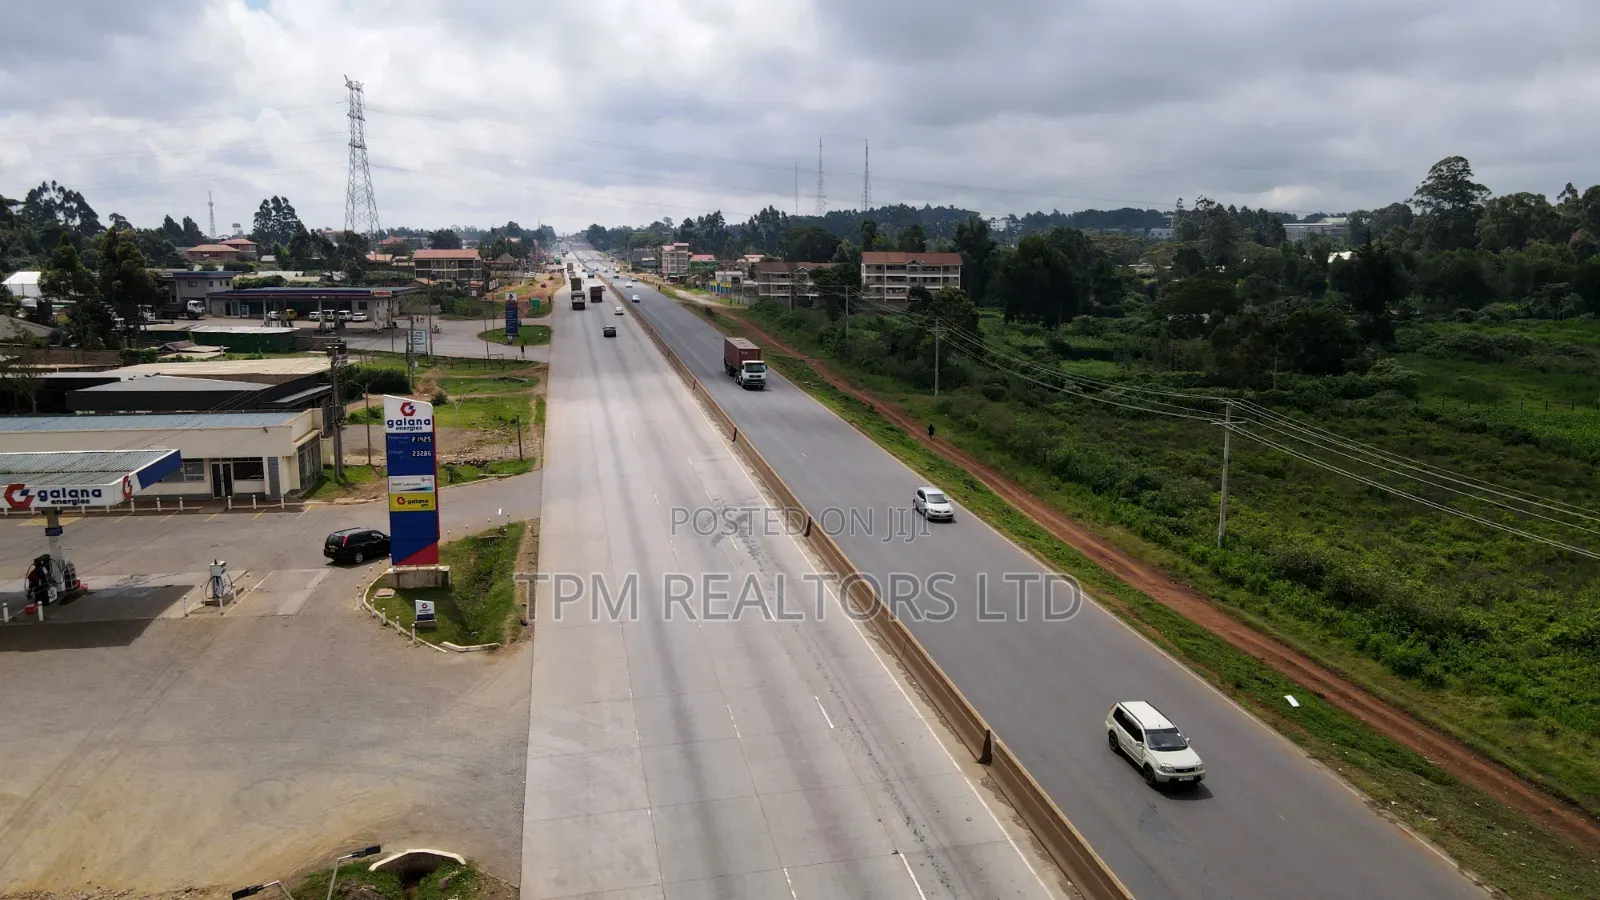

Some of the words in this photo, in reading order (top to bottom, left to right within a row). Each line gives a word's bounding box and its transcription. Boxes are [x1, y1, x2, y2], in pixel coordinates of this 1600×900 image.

[387, 418, 431, 428] galana
[38, 487, 102, 502] galana
[51, 498, 91, 506] energies
